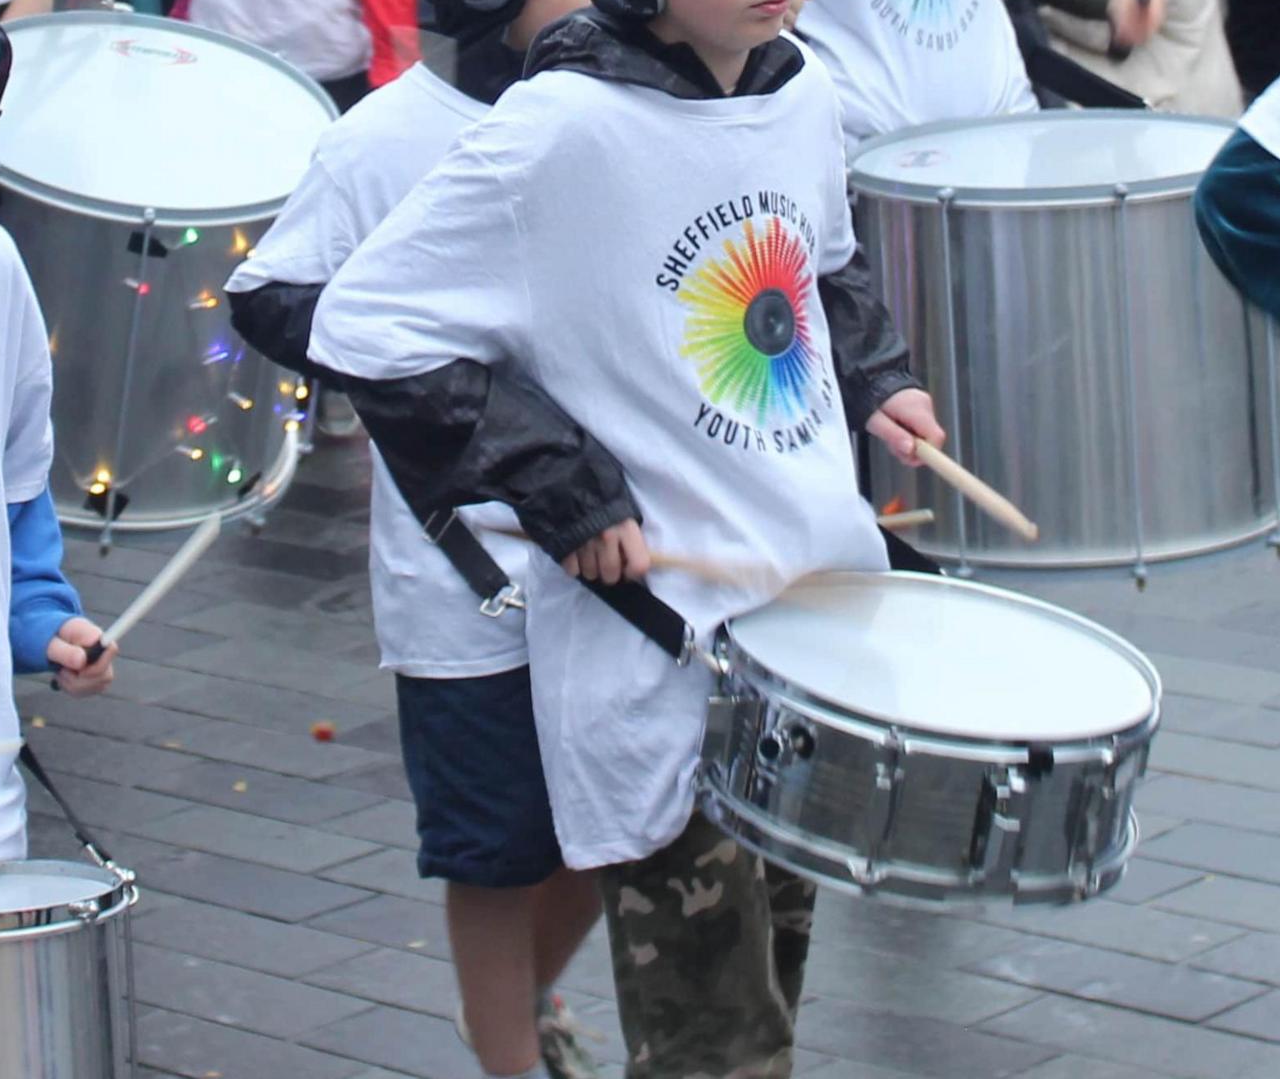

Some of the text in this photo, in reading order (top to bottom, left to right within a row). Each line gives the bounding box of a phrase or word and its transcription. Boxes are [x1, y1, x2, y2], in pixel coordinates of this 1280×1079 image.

[656, 195, 754, 293] SHEFFIELD
[758, 190, 798, 225] MUSIC
[692, 402, 767, 453] YOUTH
